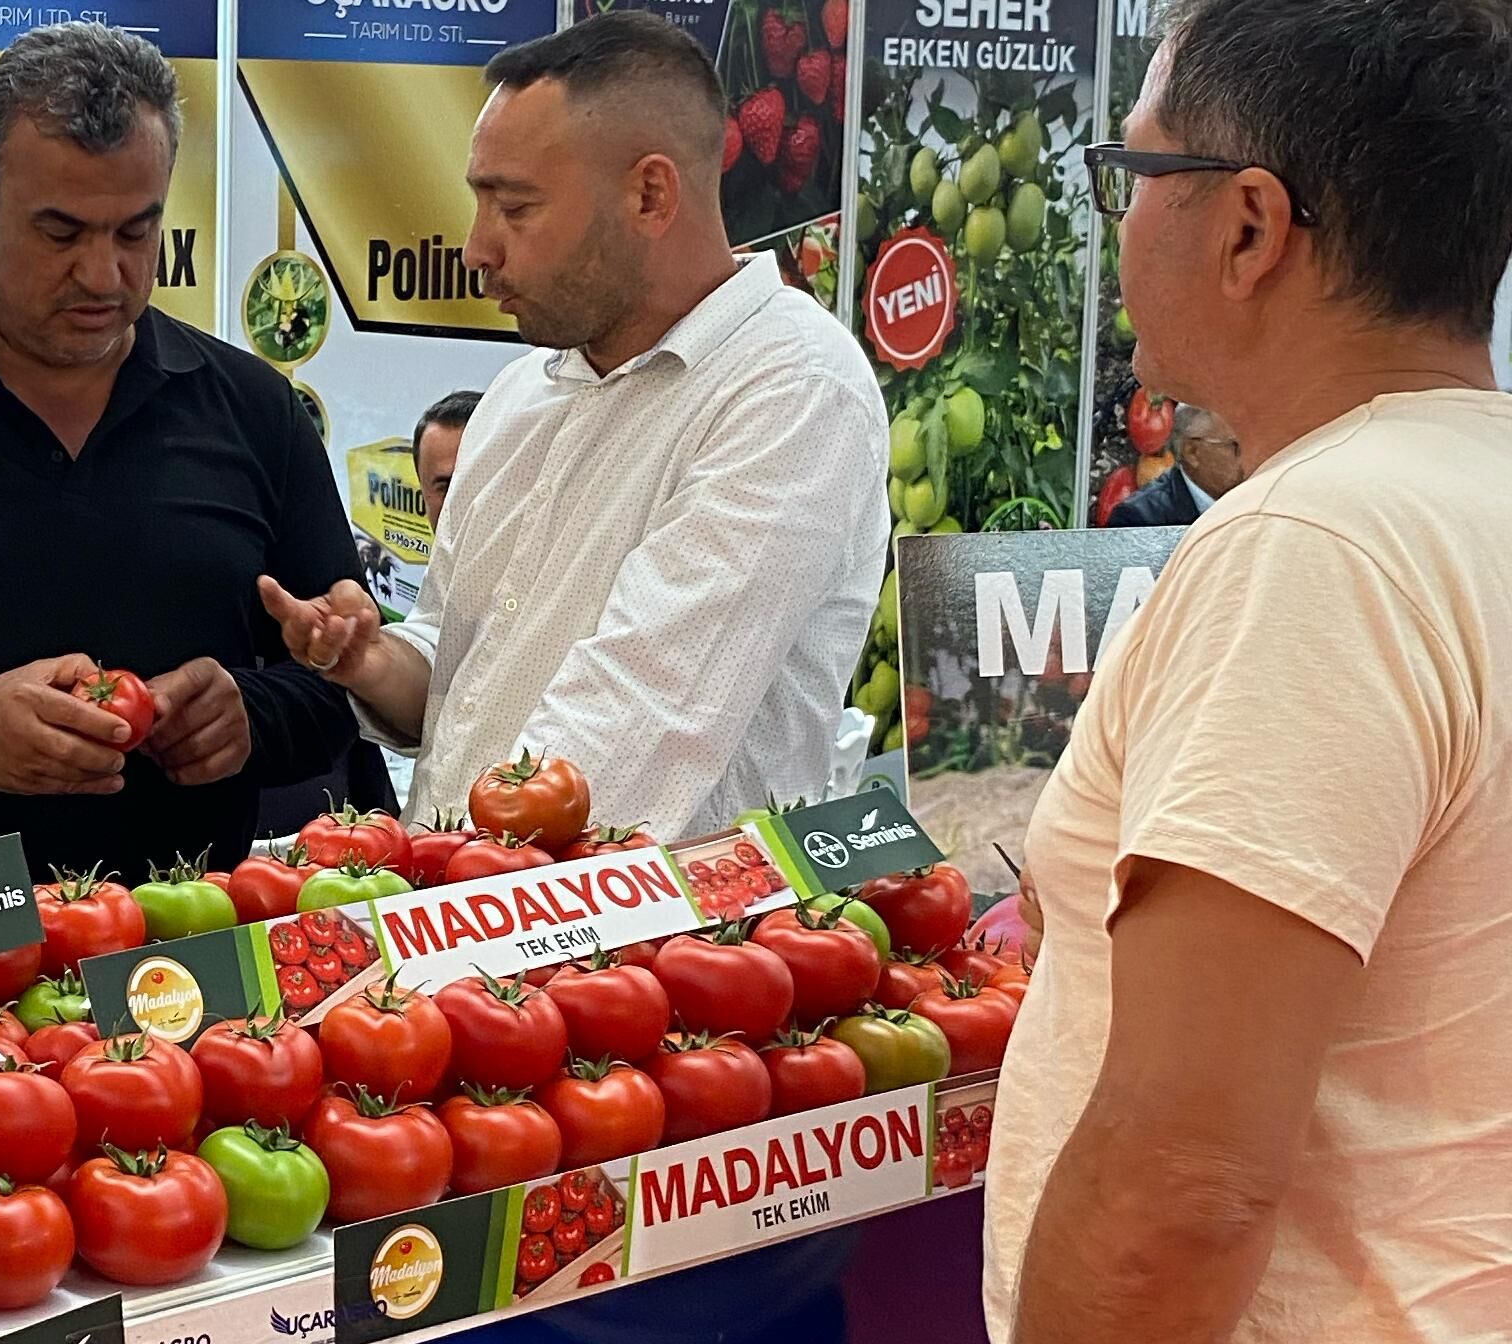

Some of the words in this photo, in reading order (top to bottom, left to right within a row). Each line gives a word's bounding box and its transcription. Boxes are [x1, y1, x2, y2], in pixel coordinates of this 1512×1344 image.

[350, 21, 399, 40] TARIM
[404, 24, 435, 42] LTD.
[883, 37, 969, 68] ERKEN
[976, 36, 1076, 73] GÜZLÜK
[877, 263, 944, 325] YENİ
[846, 822, 917, 851] Seminis
[382, 860, 682, 960] MADALYON
[515, 937, 554, 959] TEK
[556, 924, 601, 951] EKİM
[128, 986, 202, 1017] Madalyon
[640, 1104, 924, 1228] MADALYON
[752, 1202, 786, 1230] TEK
[789, 1188, 831, 1220] EKİM
[370, 1259, 441, 1290] Madalyon
